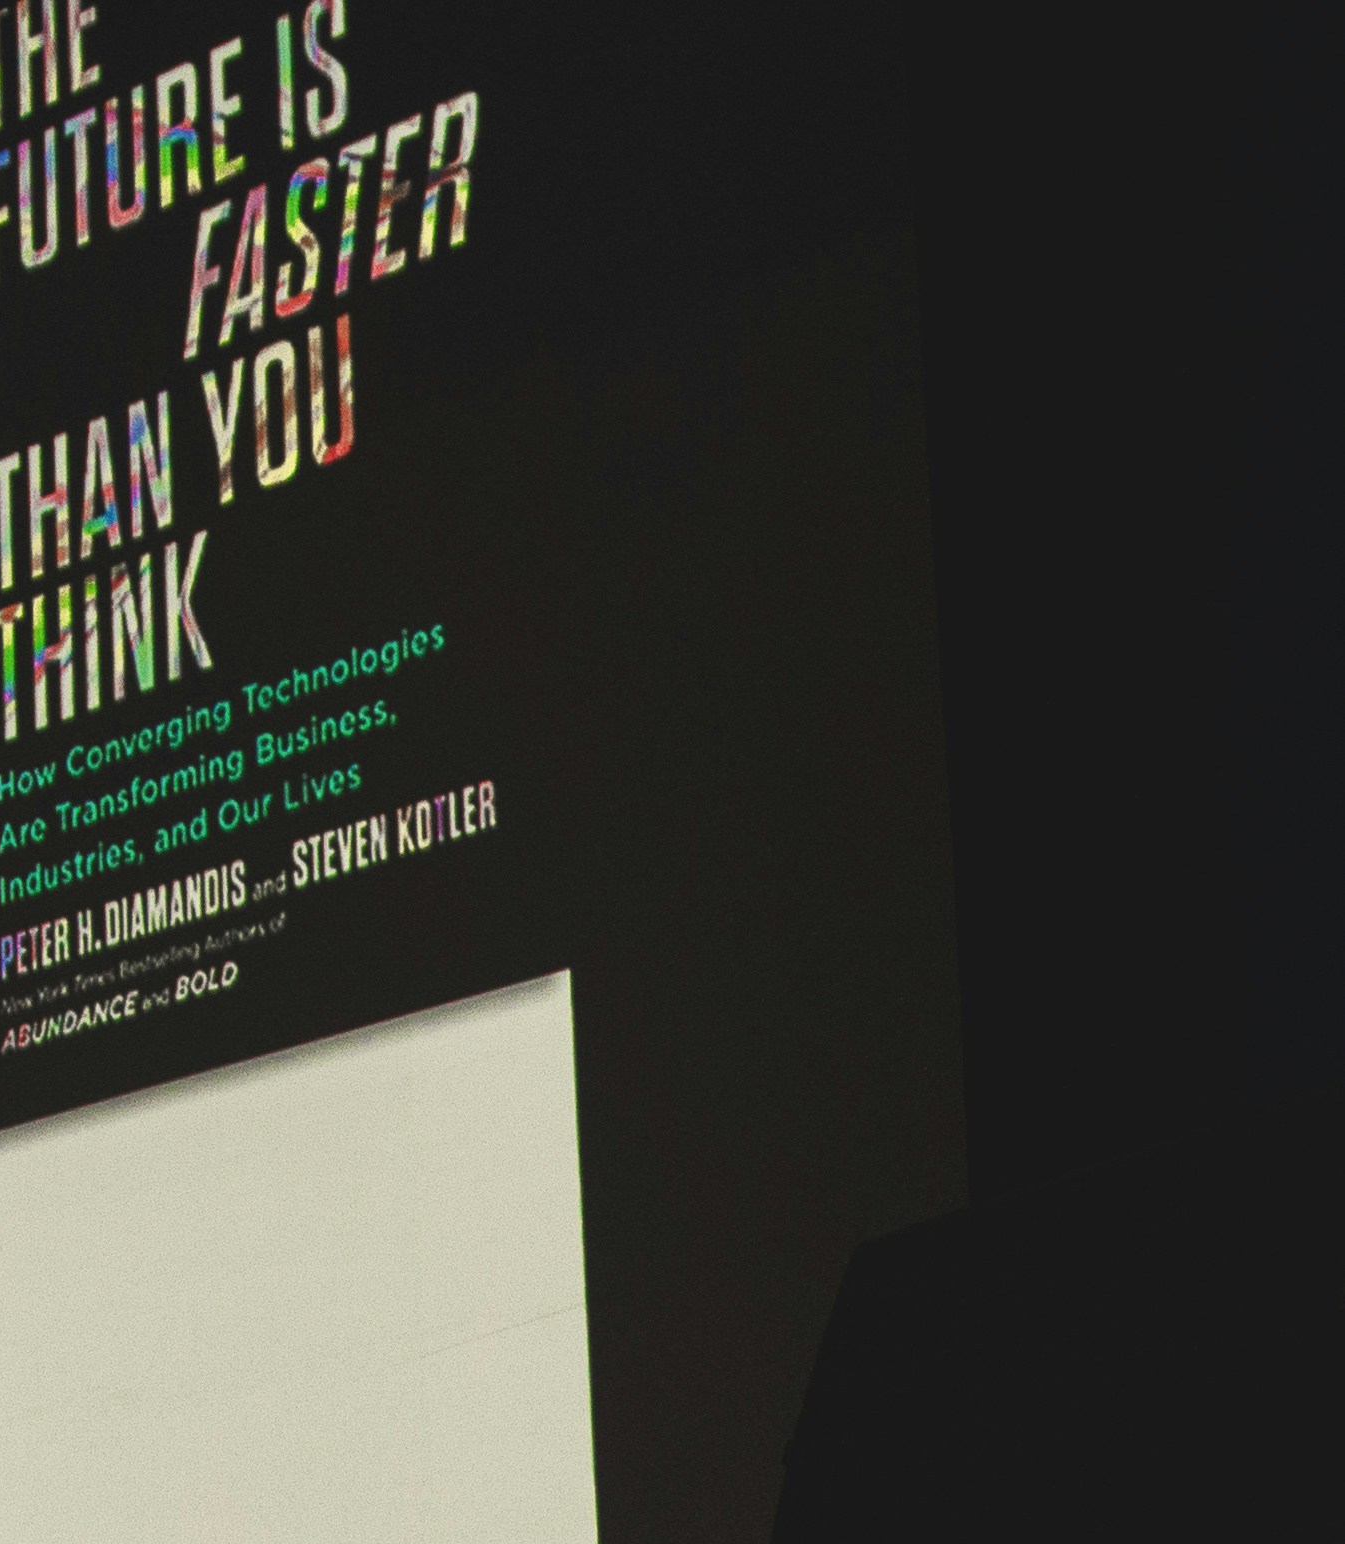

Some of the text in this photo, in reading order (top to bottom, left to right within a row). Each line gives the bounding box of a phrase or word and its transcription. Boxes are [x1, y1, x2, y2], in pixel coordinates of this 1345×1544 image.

[276, 0, 347, 150] IS
[184, 91, 478, 361] FASTER
[202, 313, 354, 505] YOU
[55, 749, 244, 836] Transforming
[256, 700, 398, 765] Business,
[66, 700, 231, 777] Converging
[242, 623, 445, 714] Technologies
[0, 763, 363, 905] Industries, and Our Lives
[0, 917, 70, 980] PETER
[252, 871, 287, 901] and
[292, 814, 387, 888] STEVEN
[397, 780, 497, 857] KOTLER
[1, 990, 139, 1053] ABUNDANCE
[175, 960, 238, 1001] BOLD
